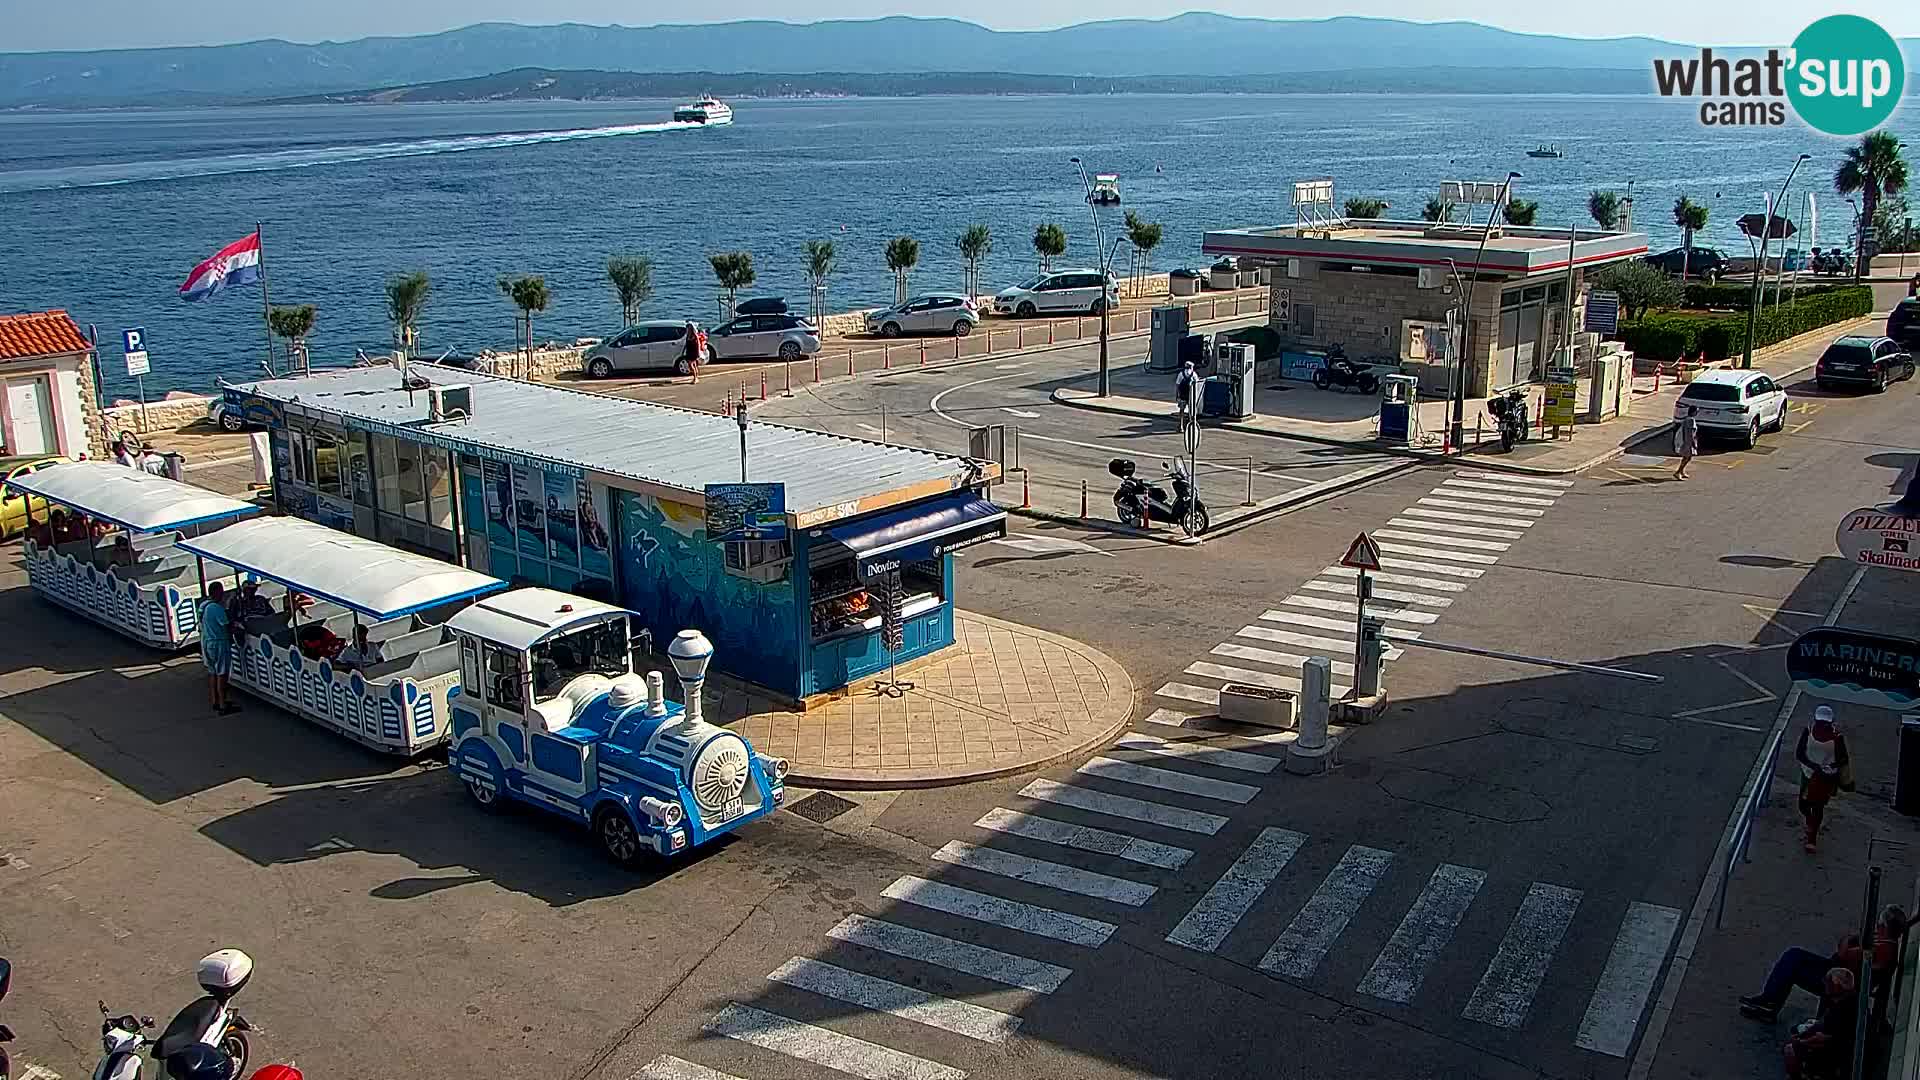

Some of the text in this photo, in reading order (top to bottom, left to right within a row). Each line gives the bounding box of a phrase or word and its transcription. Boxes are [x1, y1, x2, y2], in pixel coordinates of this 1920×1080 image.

[128, 332, 140, 350] P
[477, 447, 491, 458] BUS
[493, 450, 524, 465] STATION
[527, 457, 552, 471] TICKET
[554, 463, 580, 477] OFFICE
